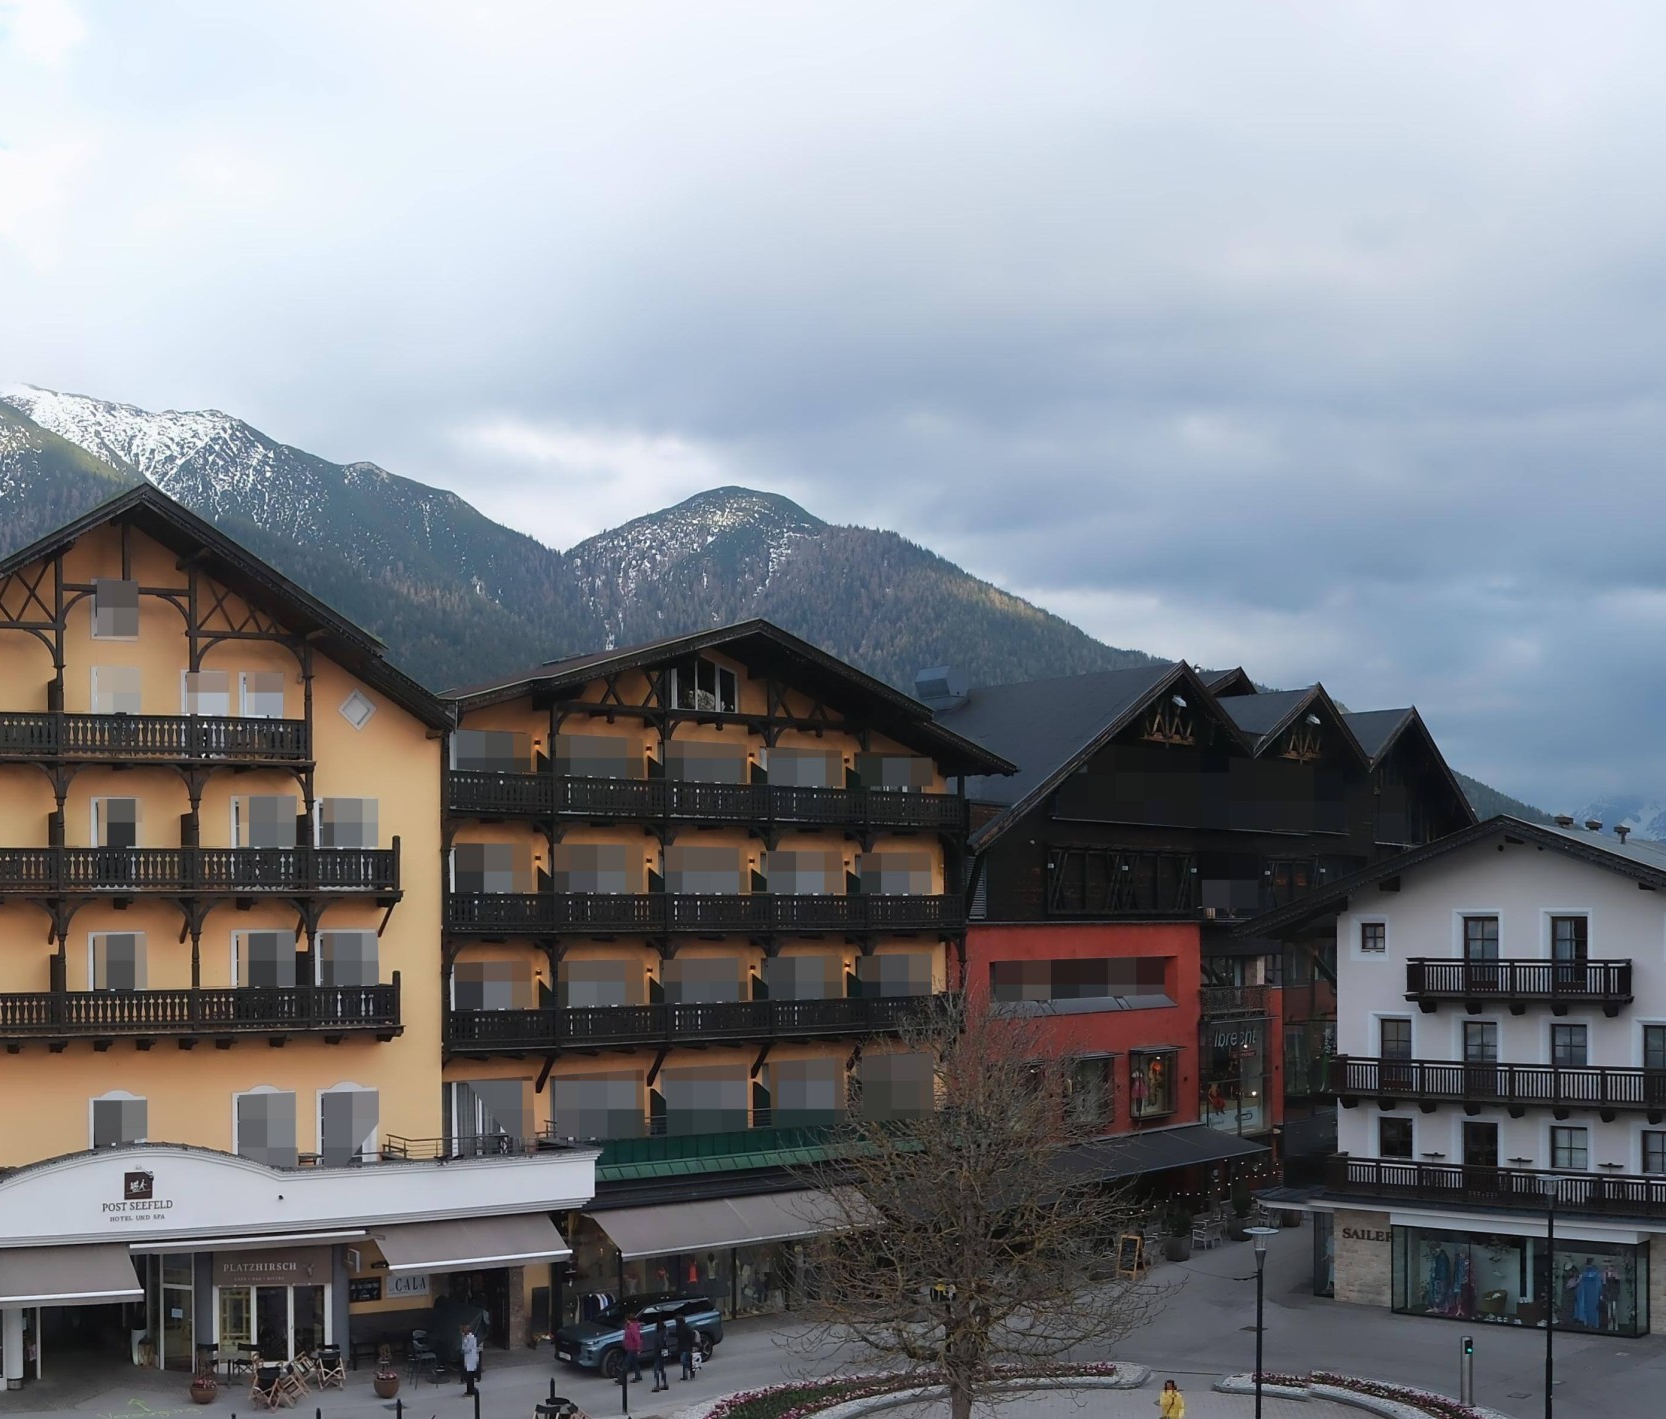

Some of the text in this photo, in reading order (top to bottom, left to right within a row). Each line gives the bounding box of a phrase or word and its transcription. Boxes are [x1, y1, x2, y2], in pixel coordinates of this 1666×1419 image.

[102, 1200, 173, 1212] POST SEEFELD
[223, 1262, 297, 1272] PLATZHIRSCH
